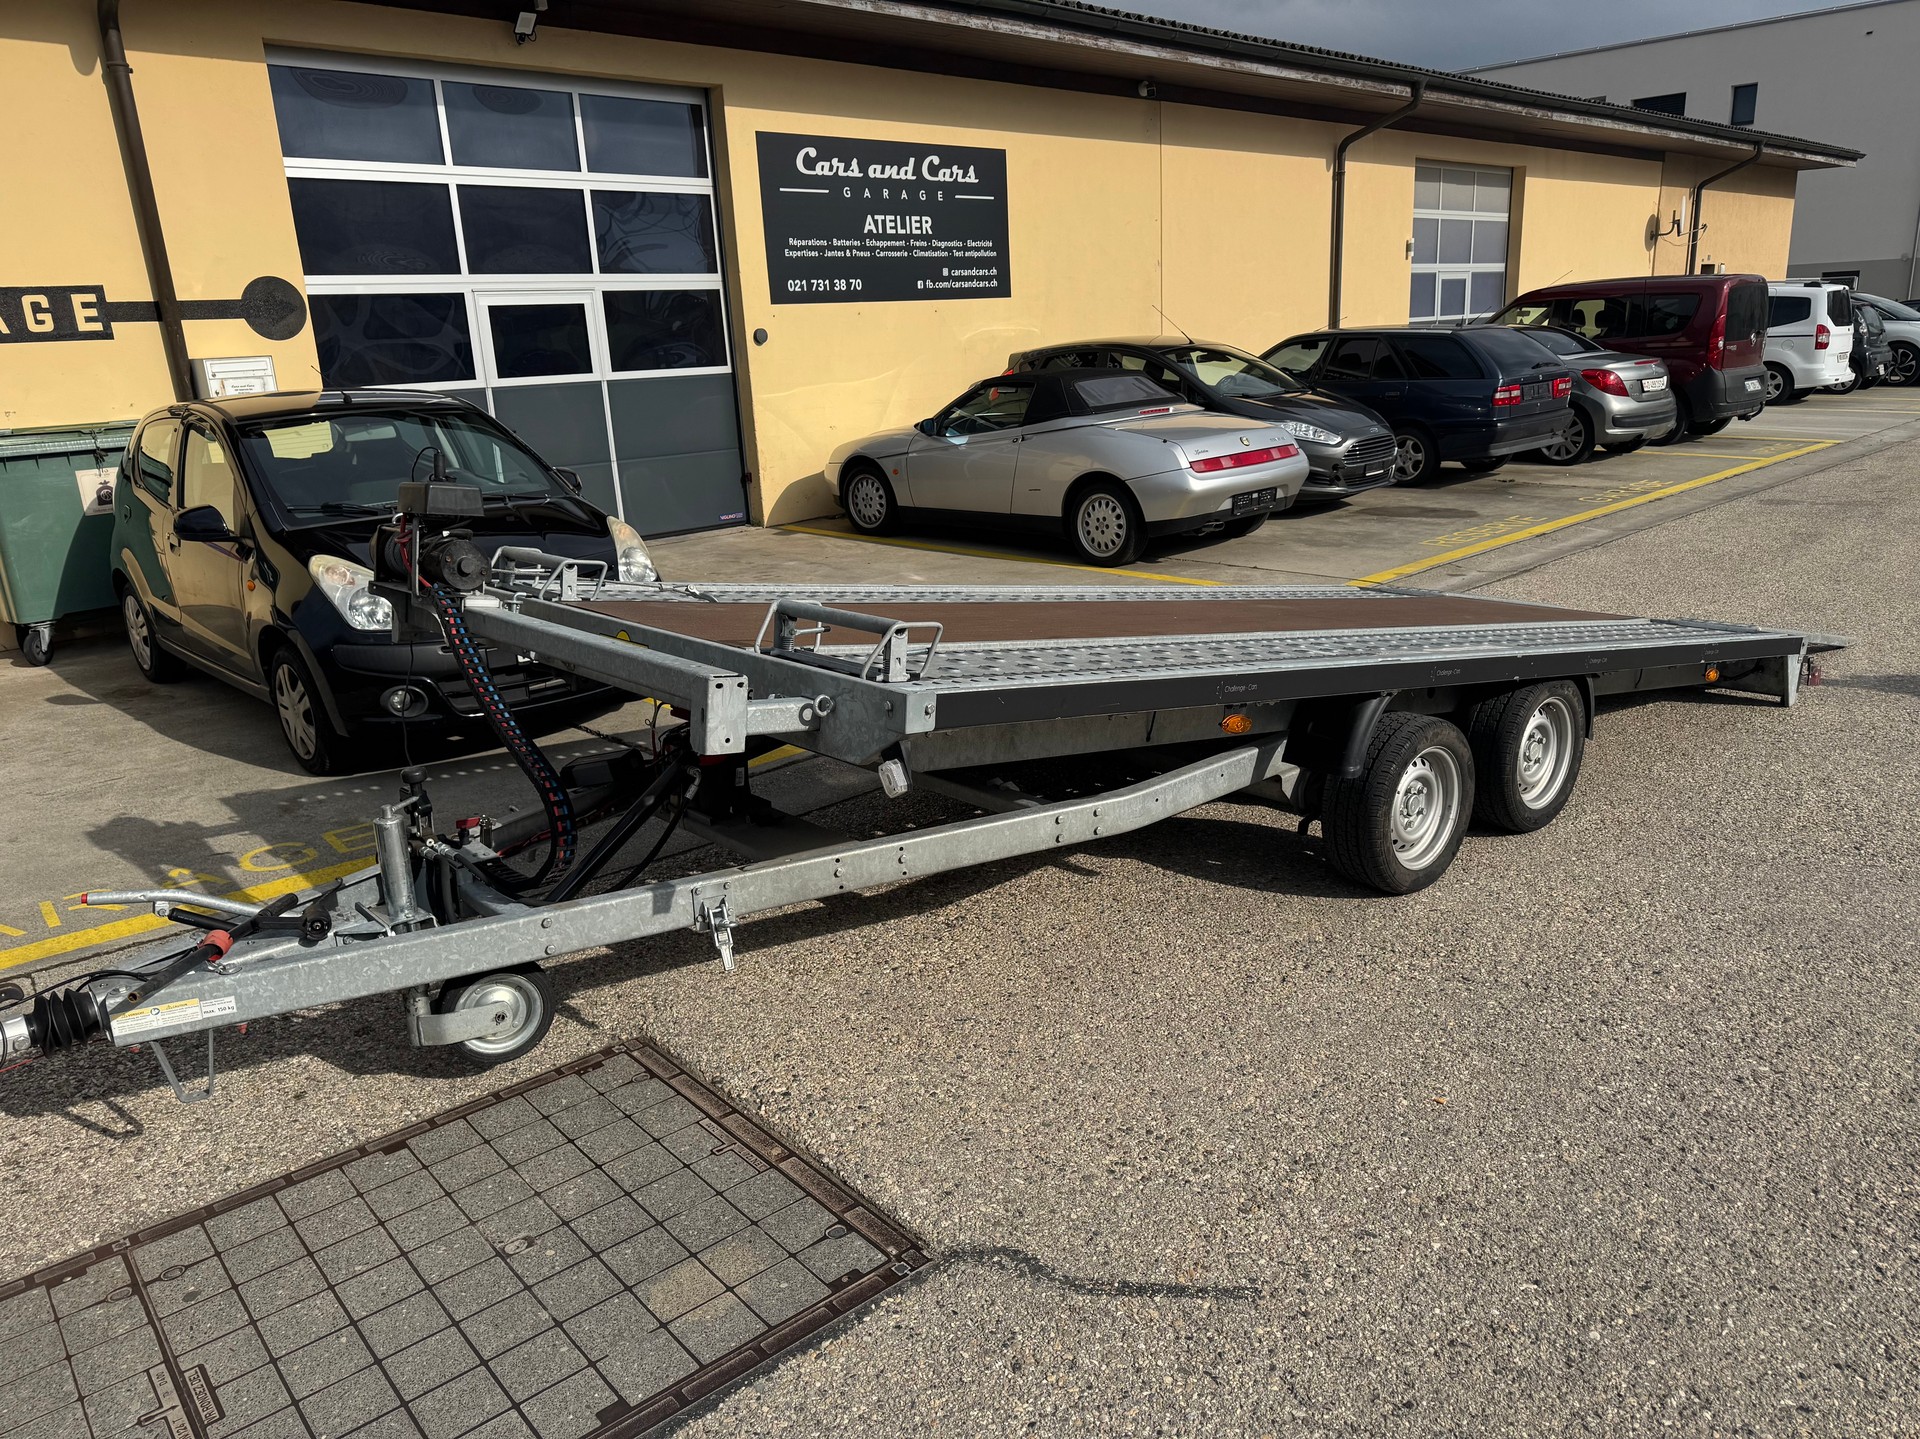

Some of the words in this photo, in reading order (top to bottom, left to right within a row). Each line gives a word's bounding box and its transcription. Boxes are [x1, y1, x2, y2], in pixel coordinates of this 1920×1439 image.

[796, 147, 863, 177] Cars
[868, 157, 916, 180] and
[922, 155, 979, 183] Cars
[843, 187, 943, 201] GARAGE
[864, 214, 933, 234] ATELIER
[788, 237, 828, 247] Réparations
[832, 238, 861, 246] Batteries
[866, 238, 906, 248] Echappement
[910, 239, 928, 247] Freins
[931, 239, 963, 248] Diagnostics
[967, 239, 993, 247] Electricité
[784, 248, 819, 258] Expertises
[823, 249, 845, 257] Jantes
[845, 249, 851, 257] &
[852, 249, 871, 257] Pneus
[875, 249, 908, 257] Carrosserie
[912, 249, 949, 257] Climatisation
[952, 249, 964, 257] Test
[964, 249, 997, 258] antipollution
[950, 266, 998, 276] carsandcars.ch
[787, 279, 807, 292] 021
[810, 279, 830, 292] 731
[833, 279, 847, 291] 38
[849, 278, 862, 291] 70
[925, 278, 998, 289] fb.com/carsandcars.ch
[0, 293, 104, 334] GE
